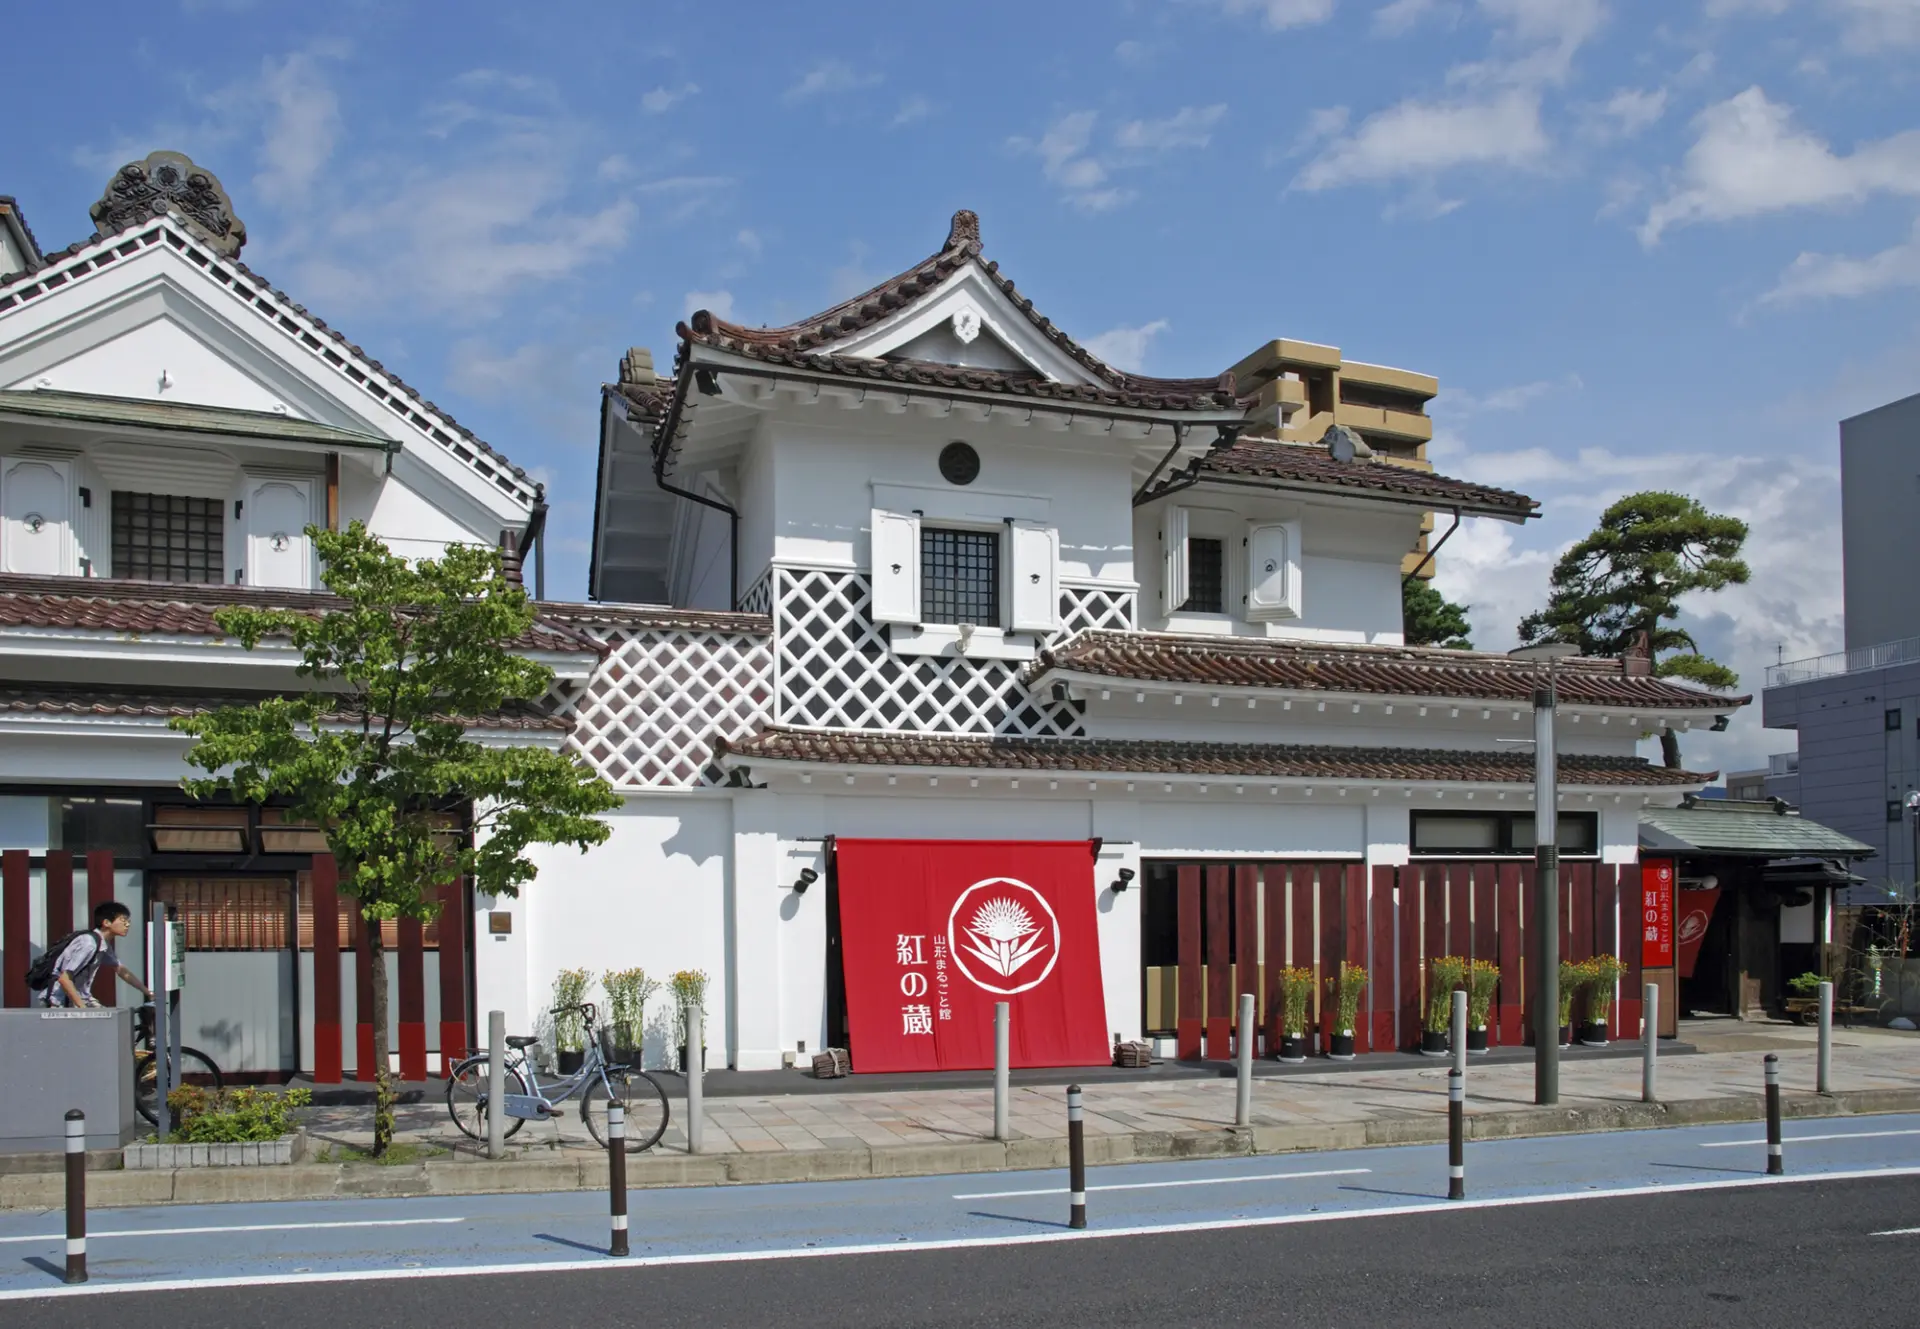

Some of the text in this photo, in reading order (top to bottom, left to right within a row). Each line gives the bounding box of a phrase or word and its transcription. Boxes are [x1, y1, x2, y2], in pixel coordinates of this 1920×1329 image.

[1645, 891, 1658, 942] 紅の蔵
[896, 934, 934, 1035] 紅の蔵
[933, 934, 951, 1020] 山形まるごと館
